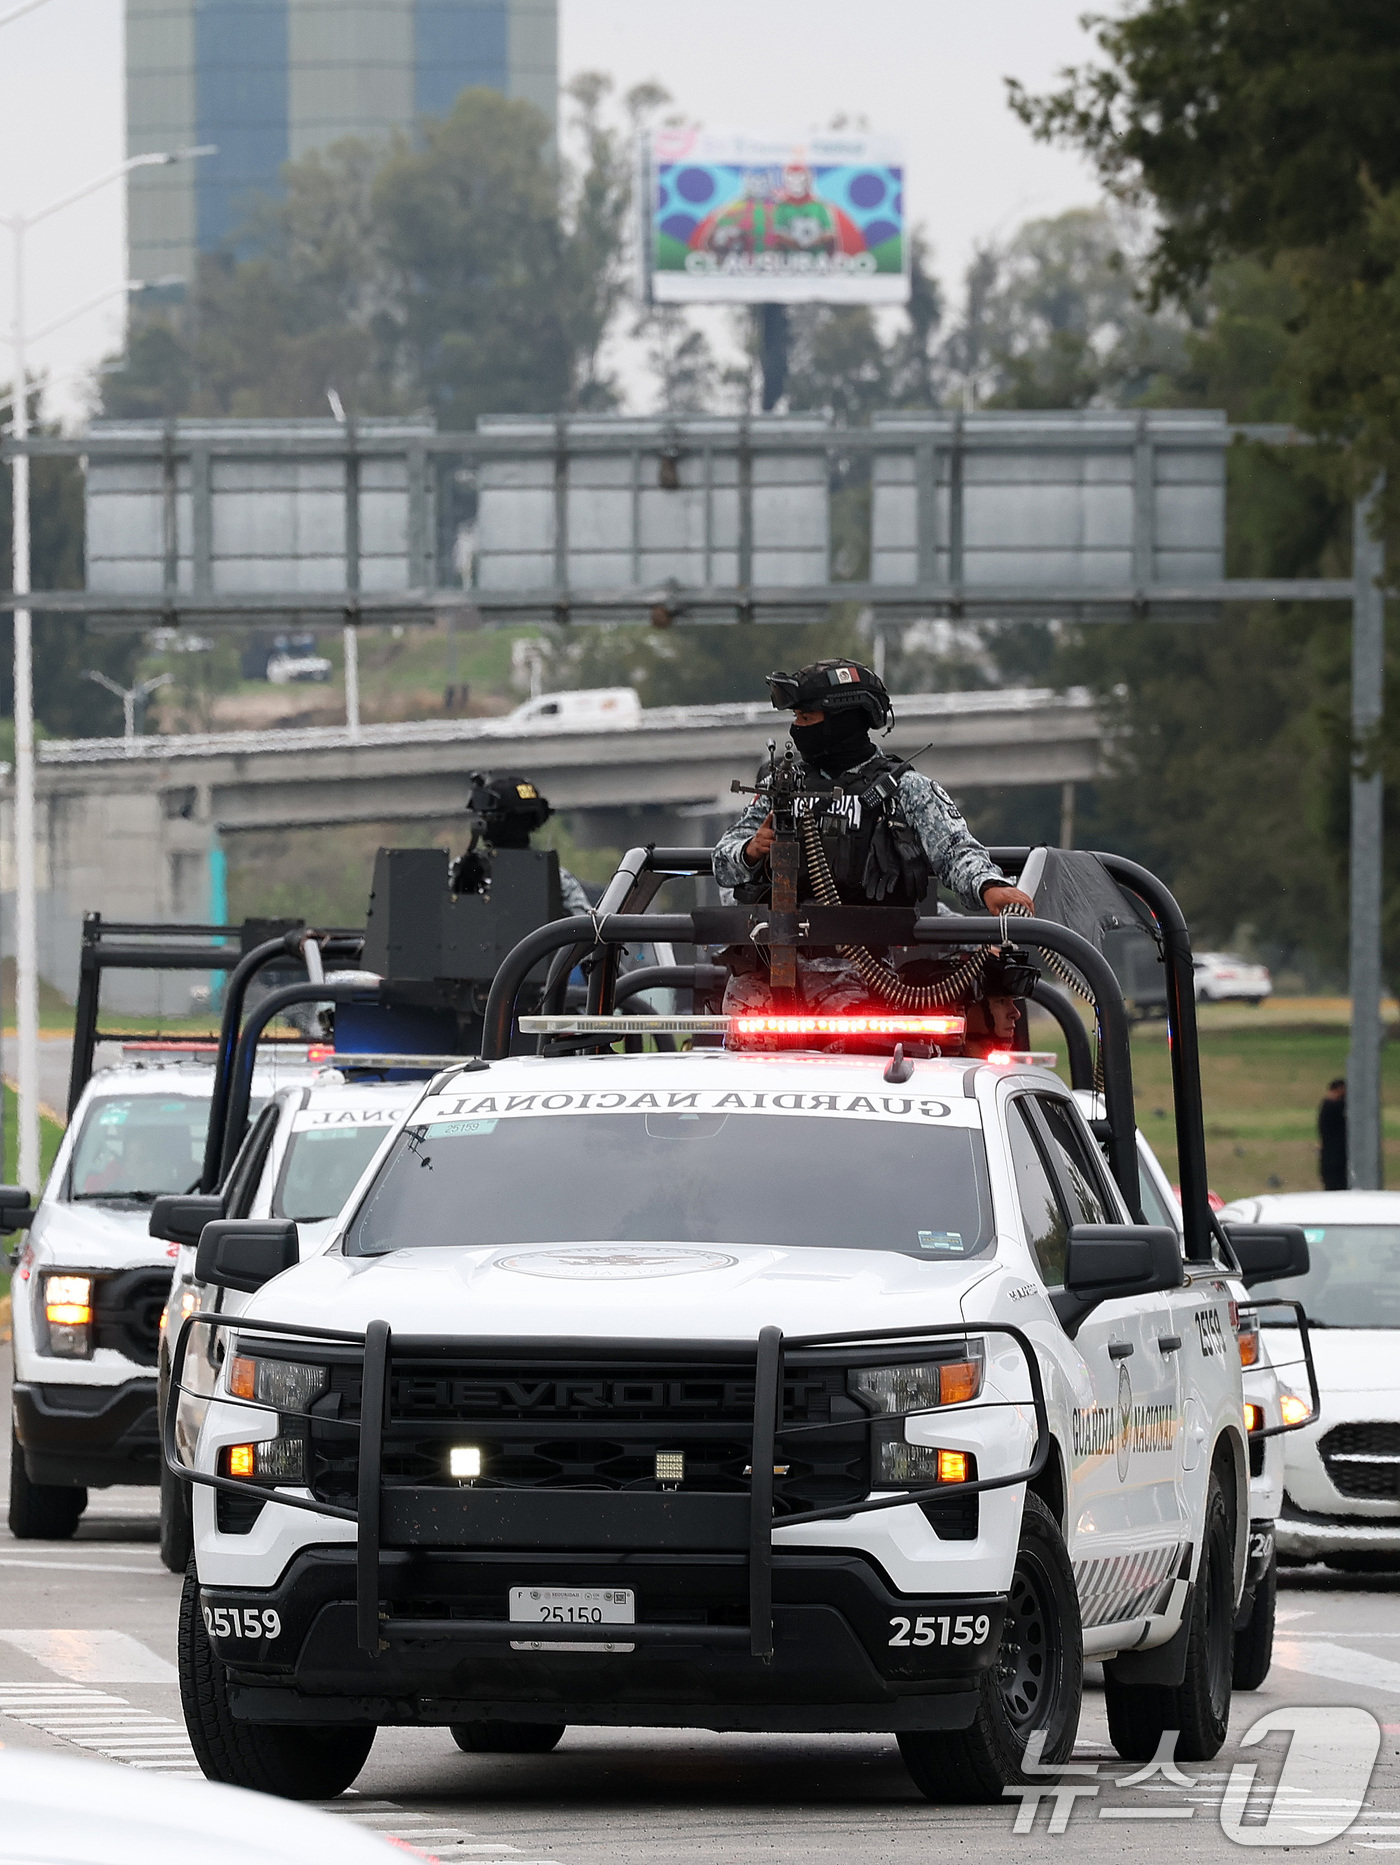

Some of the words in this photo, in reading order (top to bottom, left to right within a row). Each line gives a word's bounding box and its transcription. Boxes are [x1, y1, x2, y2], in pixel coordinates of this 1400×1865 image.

[445, 1122, 480, 1134] 25159
[1195, 1308, 1227, 1357] 25159
[350, 1378, 826, 1408] HEVROLET
[1072, 1407, 1115, 1456] GUARDIA
[1132, 1405, 1173, 1453] NACIONAL
[204, 1606, 282, 1640] 25159
[888, 1614, 991, 1647] 25159
